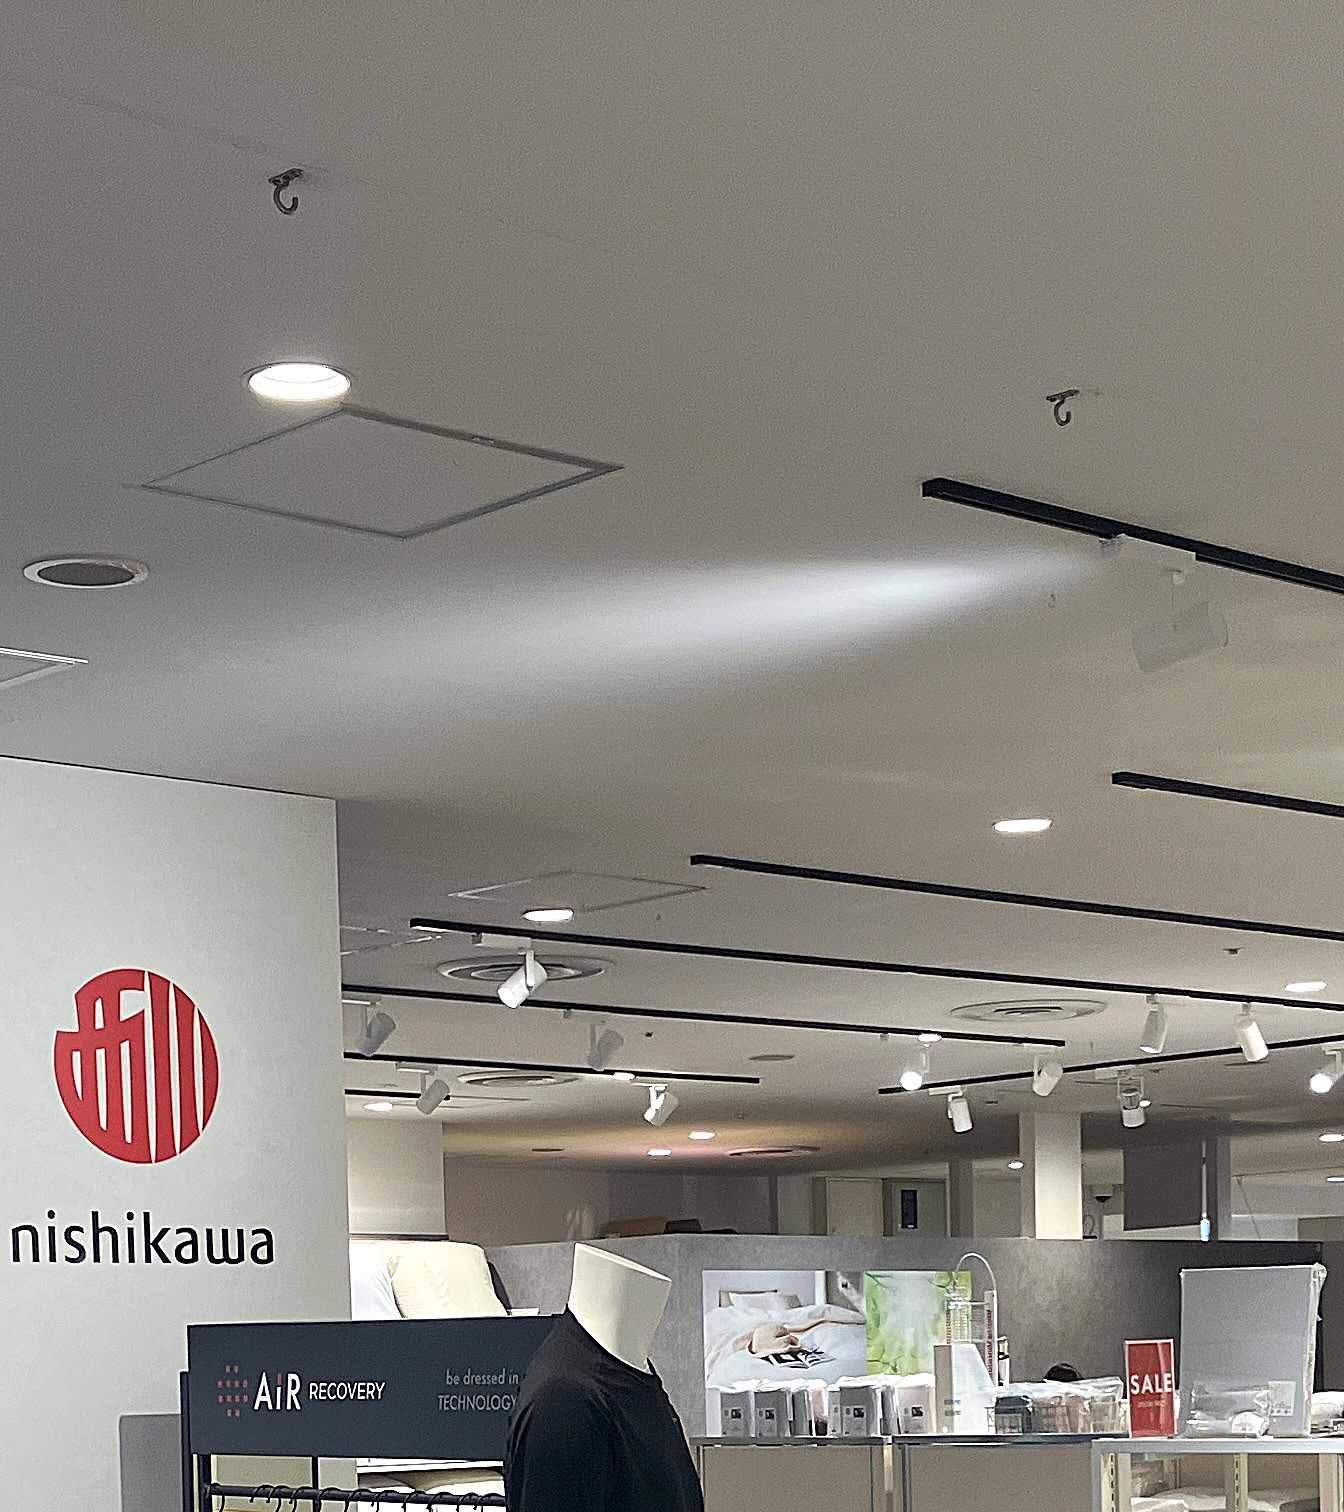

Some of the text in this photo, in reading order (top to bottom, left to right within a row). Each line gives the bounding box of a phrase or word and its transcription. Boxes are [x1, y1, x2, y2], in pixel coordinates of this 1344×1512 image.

[11, 1210, 275, 1266] nishikawa
[446, 1366, 519, 1385] be dressed in
[1130, 1373, 1173, 1395] SALE
[309, 1381, 385, 1400] RECOVERY
[438, 1394, 517, 1411] TECHNOLOGY
